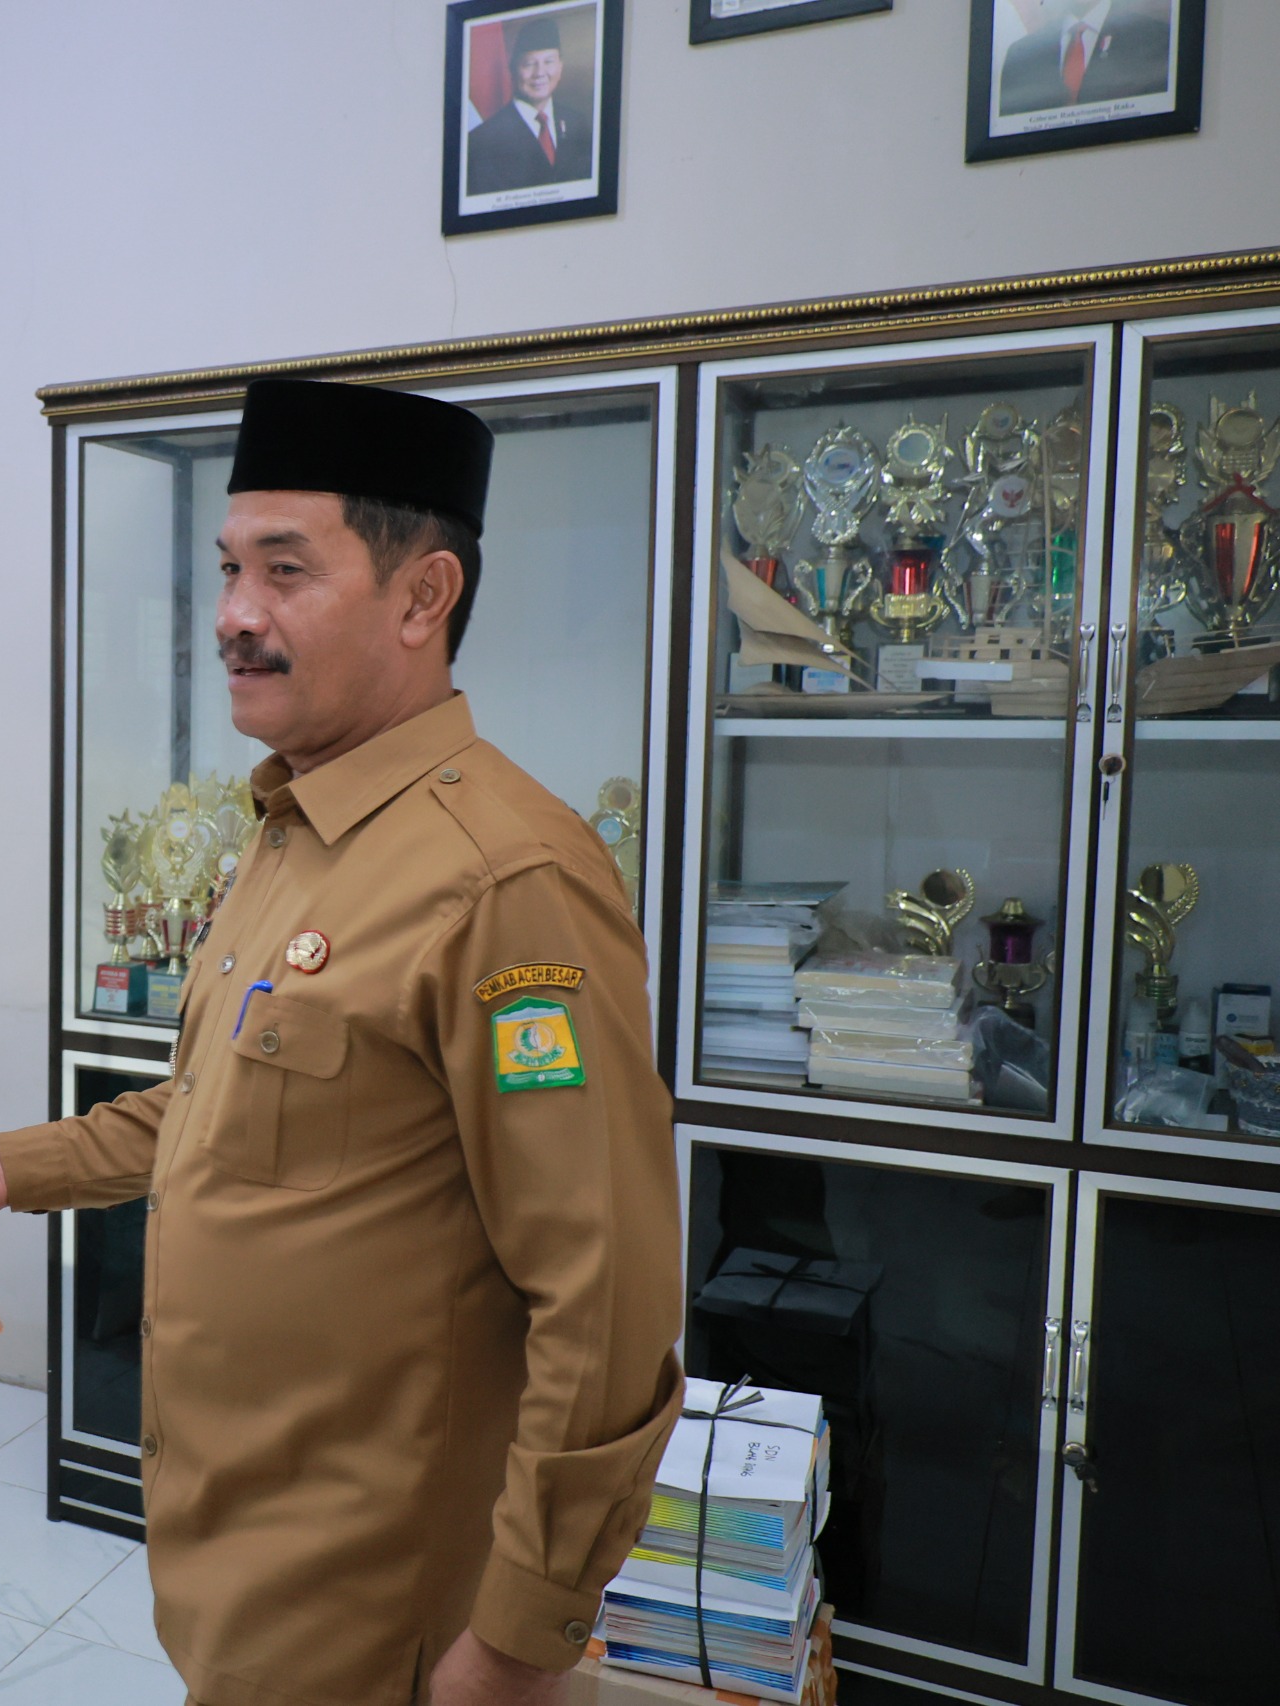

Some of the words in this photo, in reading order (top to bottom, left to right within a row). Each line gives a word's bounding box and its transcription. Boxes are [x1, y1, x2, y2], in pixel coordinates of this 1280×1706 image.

[478, 972, 518, 996] PEMKAB
[518, 966, 544, 985] ACEH
[545, 967, 578, 988] BESAR
